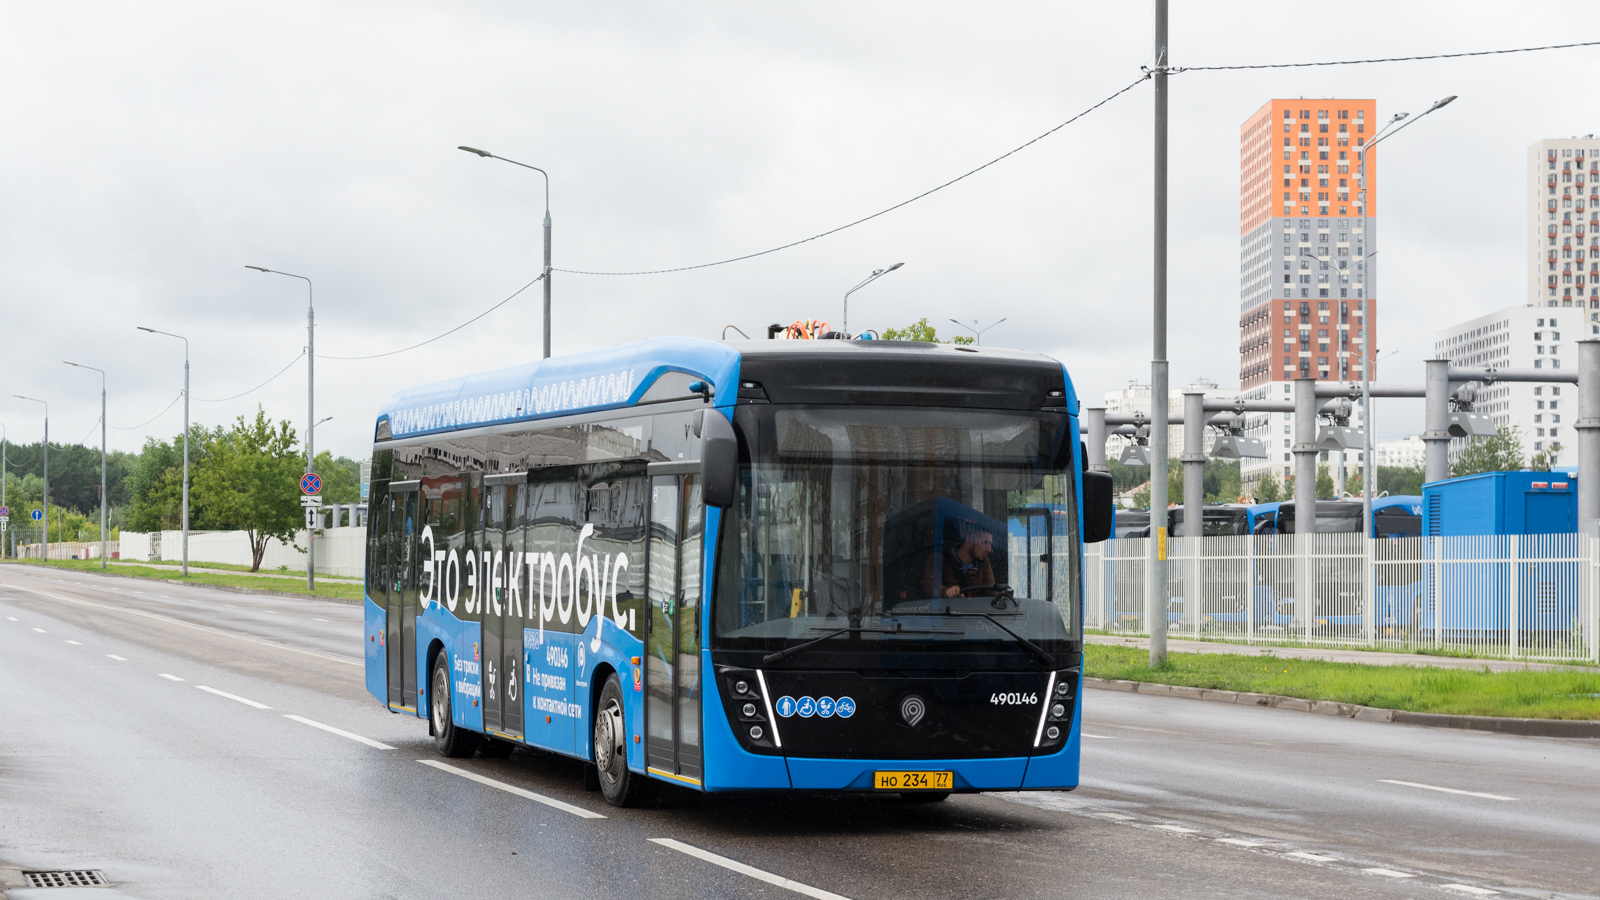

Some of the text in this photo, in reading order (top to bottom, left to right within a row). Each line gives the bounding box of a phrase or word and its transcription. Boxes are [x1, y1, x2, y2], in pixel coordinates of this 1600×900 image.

[420, 523, 636, 653] Это электробус.
[454, 654, 479, 676] Без тряски
[547, 645, 569, 668] 490146
[532, 667, 541, 686] Не
[541, 673, 566, 691] привязан
[537, 698, 567, 716] контактной
[567, 705, 582, 719] сети
[990, 692, 1038, 705] 490146
[881, 773, 949, 787] НО 234 77
